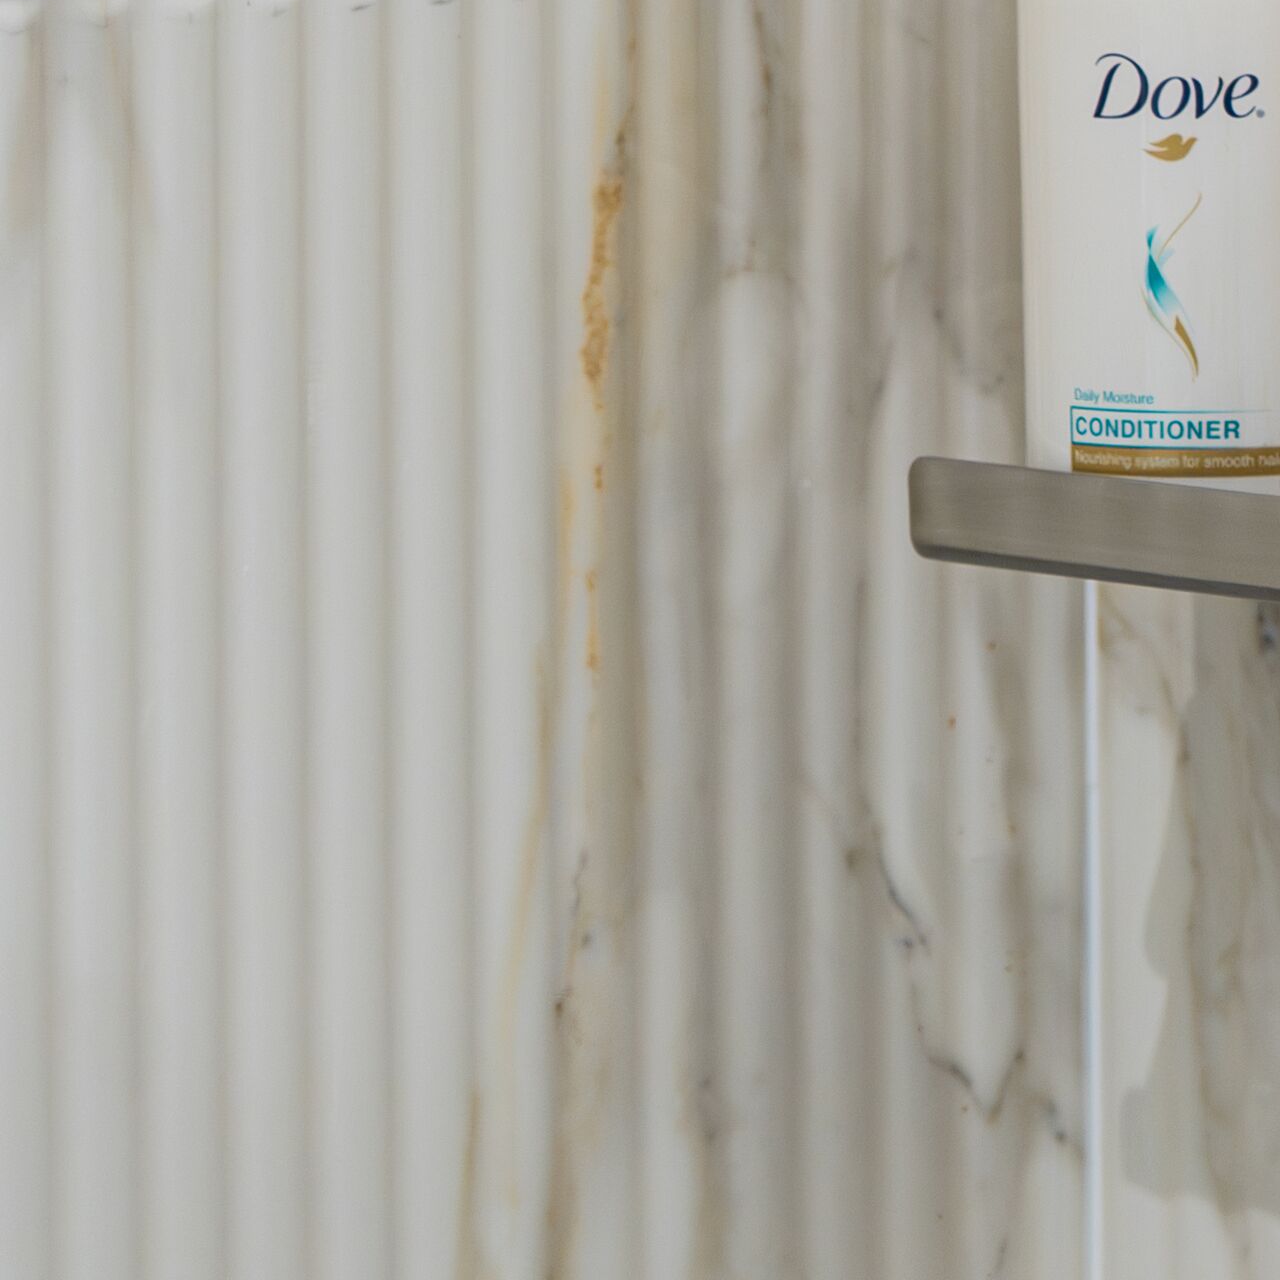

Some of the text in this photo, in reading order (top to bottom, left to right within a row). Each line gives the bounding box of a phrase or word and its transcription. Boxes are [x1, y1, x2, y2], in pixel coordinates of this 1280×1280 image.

[1093, 53, 1260, 120] Dove
[1074, 387, 1154, 405] Daily Moisture
[1075, 415, 1240, 440] CONDITIONER
[1075, 448, 1132, 469] Nourishing
[1134, 455, 1180, 469] system
[1183, 454, 1200, 467] for
[1204, 454, 1255, 468] smooth
